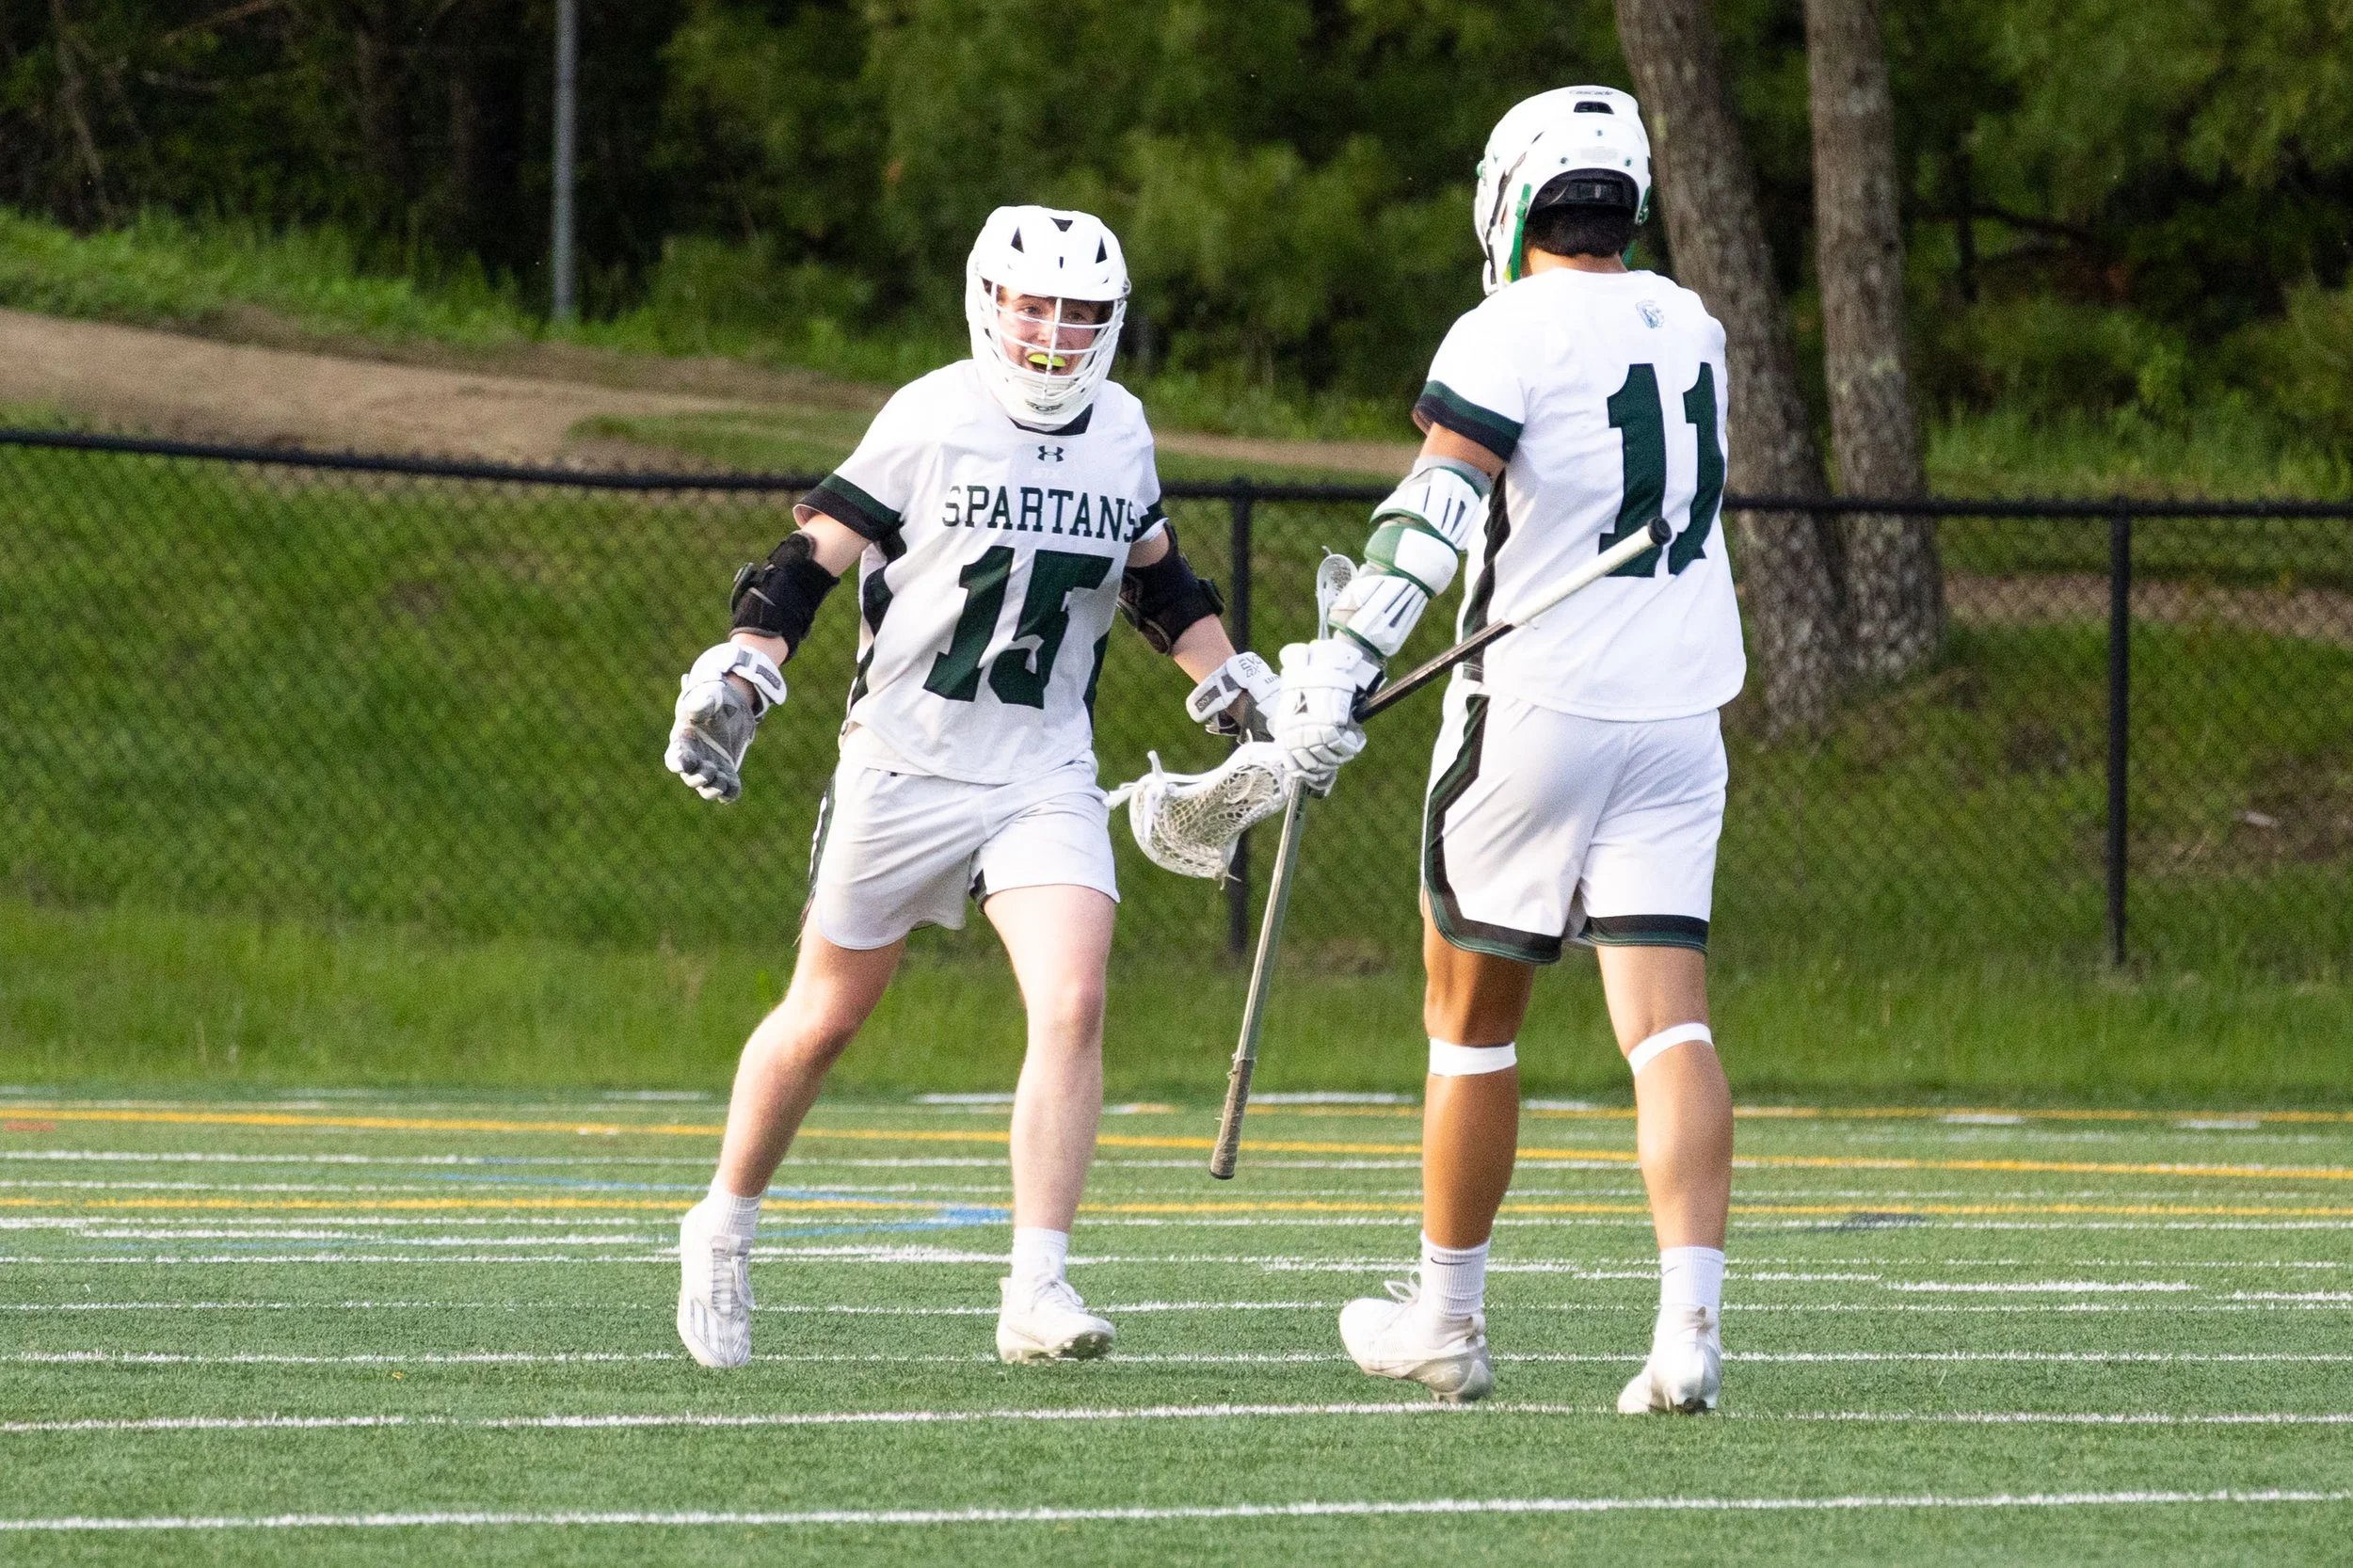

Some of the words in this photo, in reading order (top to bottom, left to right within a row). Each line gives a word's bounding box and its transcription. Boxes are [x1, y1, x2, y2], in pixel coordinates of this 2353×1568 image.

[942, 485, 1135, 543] SPARTANS
[1598, 361, 1725, 578] 11
[923, 545, 1114, 710] 15
